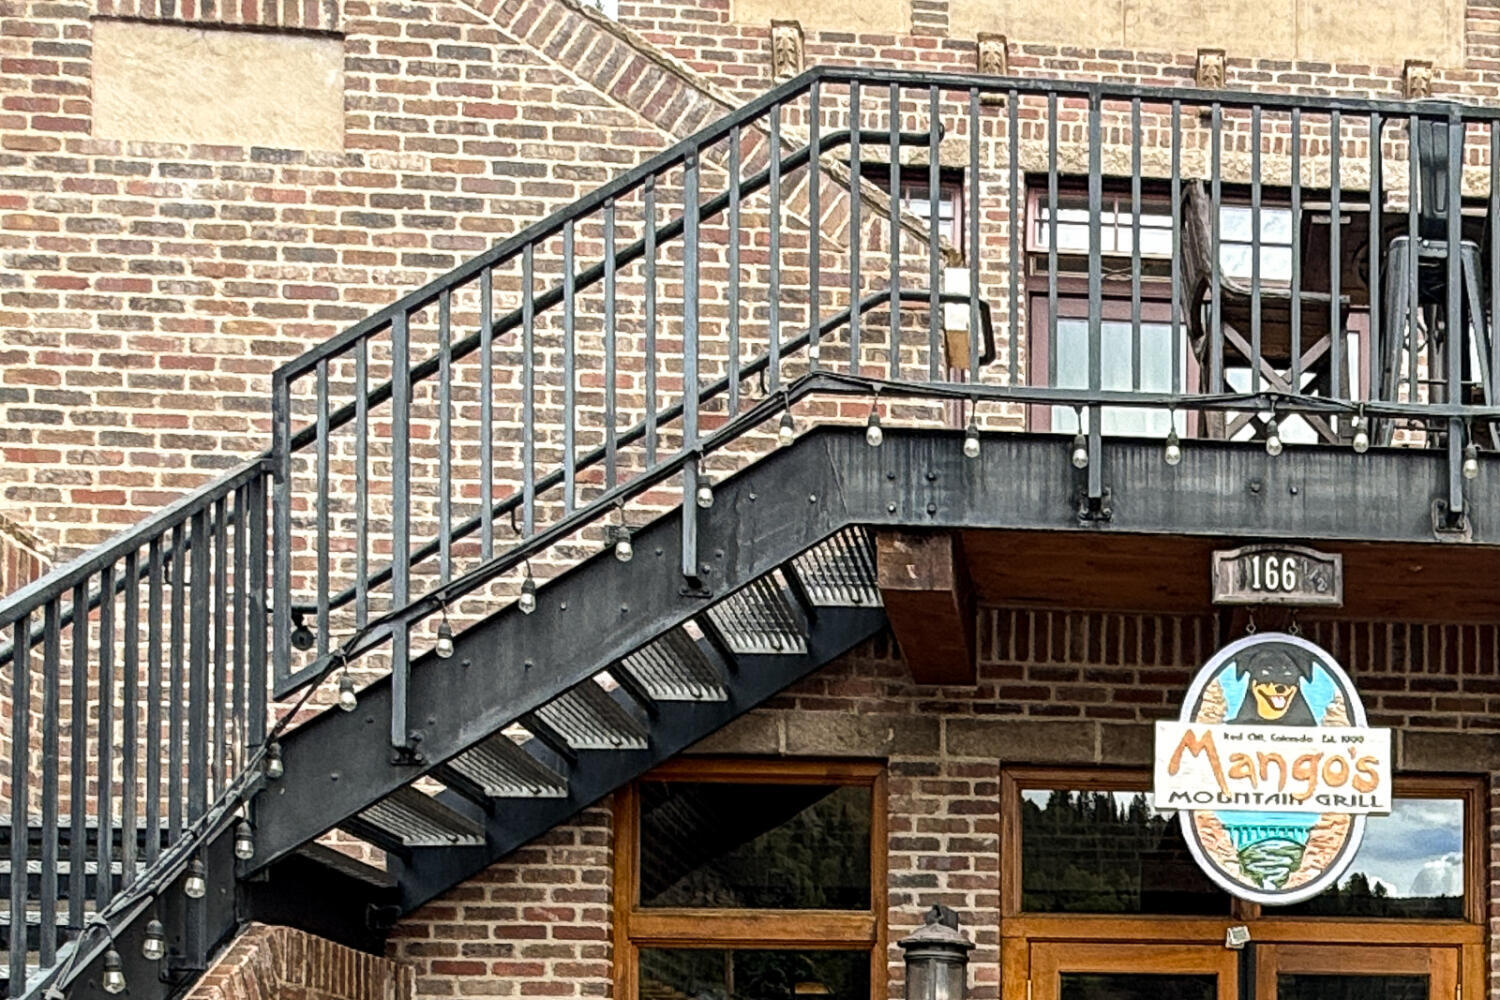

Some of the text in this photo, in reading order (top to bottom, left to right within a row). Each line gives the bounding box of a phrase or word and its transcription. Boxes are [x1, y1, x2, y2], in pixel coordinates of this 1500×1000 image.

[1252, 555, 1296, 590] 166
[1168, 729, 1380, 802] Mango's
[1168, 791, 1384, 808] MOUNTAIN GRILL
